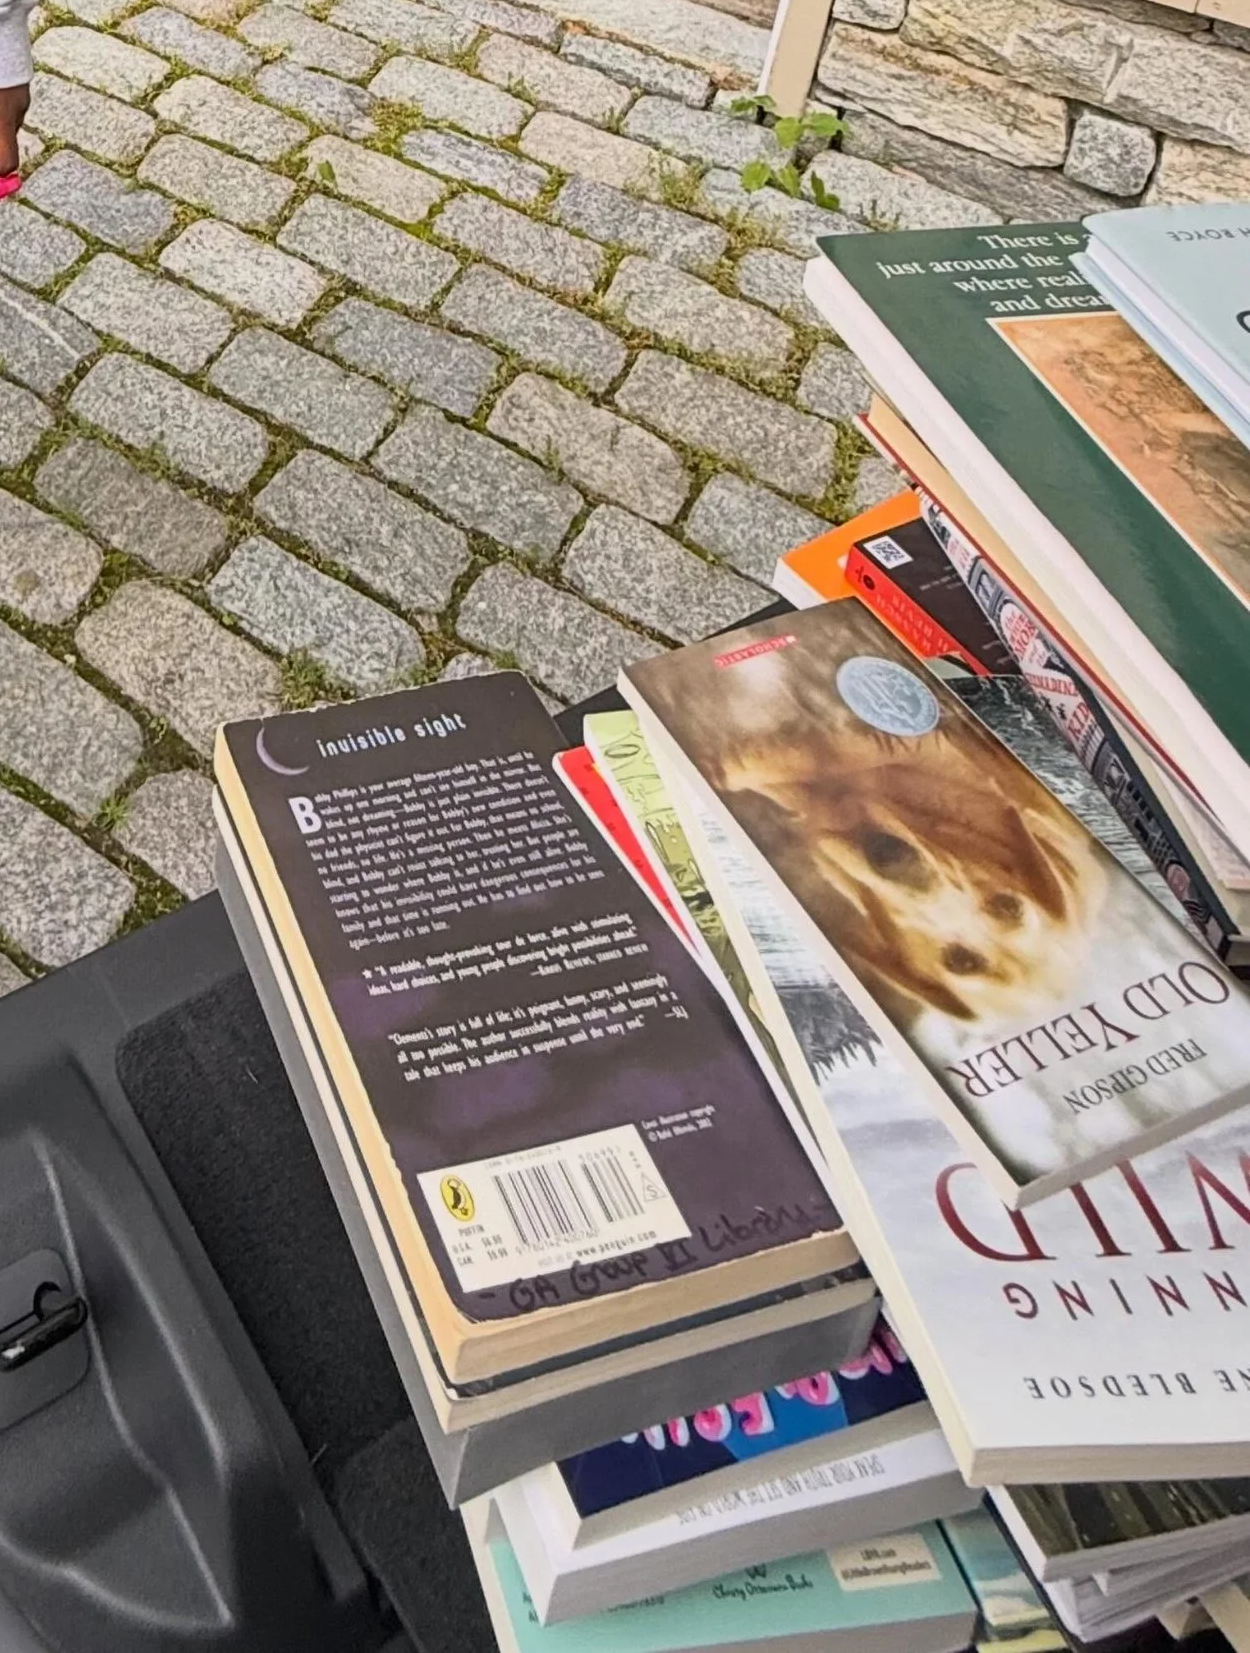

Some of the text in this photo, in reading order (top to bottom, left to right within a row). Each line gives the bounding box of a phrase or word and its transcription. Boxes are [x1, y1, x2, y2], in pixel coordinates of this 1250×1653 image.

[977, 232, 1079, 249] There is
[876, 253, 1063, 279] just around the
[953, 272, 1087, 293] where real
[990, 294, 1040, 312] and
[413, 712, 468, 741] sight
[946, 961, 1230, 1097] OLD YELLER
[1063, 1038, 1208, 1115] FRED GIPSON
[457, 1223, 485, 1238] PUFFIN
[569, 1252, 651, 1290] Group
[697, 1204, 816, 1254] Library
[1002, 1270, 1248, 1321] NNING
[1023, 1372, 1198, 1400] BLEDSOE
